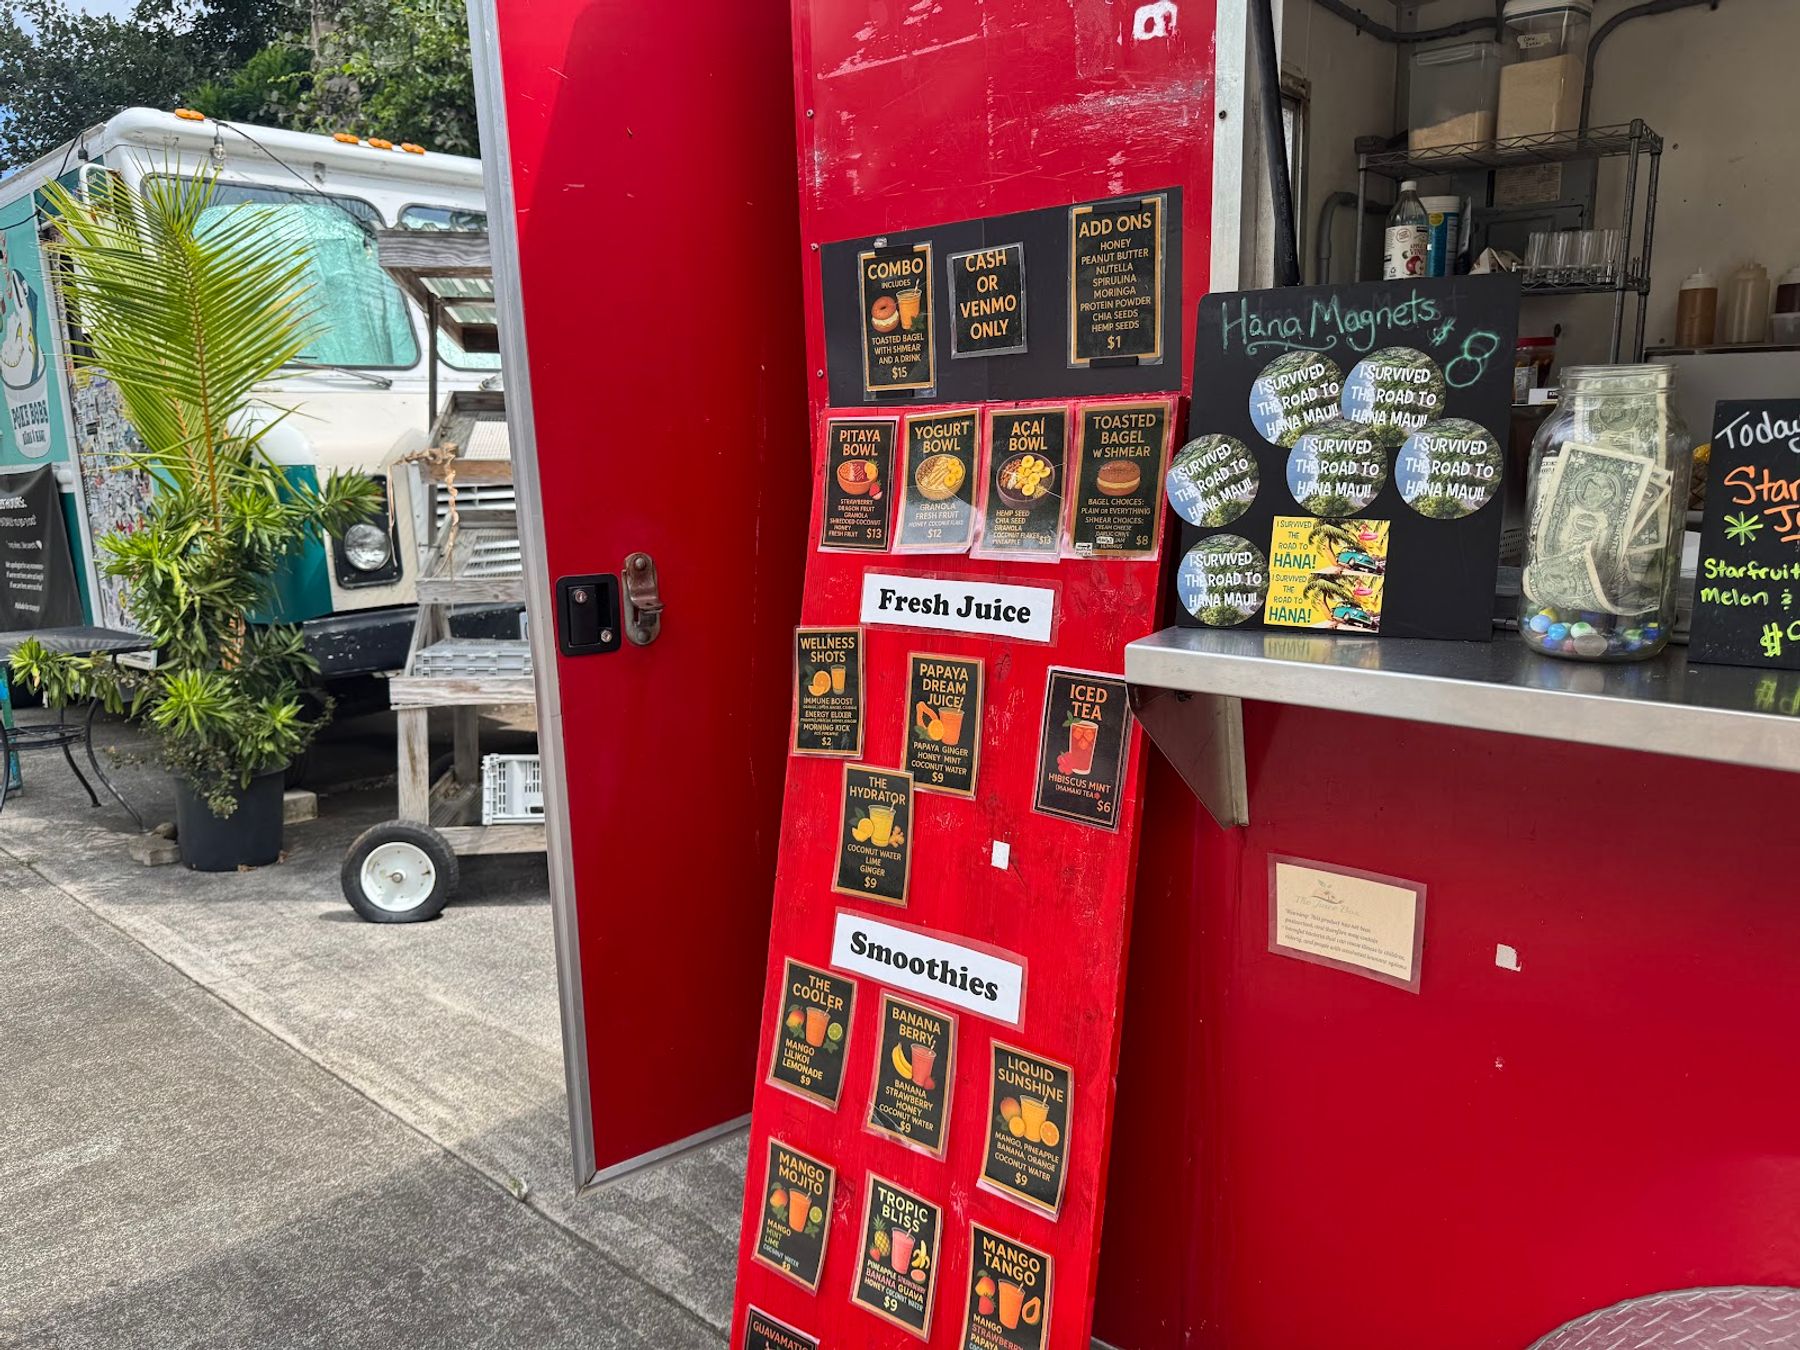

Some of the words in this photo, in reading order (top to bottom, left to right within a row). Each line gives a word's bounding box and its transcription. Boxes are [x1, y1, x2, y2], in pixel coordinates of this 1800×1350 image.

[1079, 219, 1112, 238] ADD
[1117, 212, 1152, 232] ONS
[1101, 238, 1131, 250] HONEY
[965, 249, 1007, 272] CASH
[1081, 252, 1114, 265] PEANUT
[1117, 248, 1149, 261] BUTTER
[868, 258, 923, 279] COMBO
[1096, 263, 1133, 275] NUTELLA
[881, 279, 911, 289] INCLUDES
[977, 275, 998, 292] OR
[1093, 274, 1137, 287] SPIRULINA
[1094, 286, 1136, 298] MORINGA
[960, 295, 1016, 318] VENMO
[1080, 299, 1113, 311] PROTEIN
[1115, 297, 1151, 308] POWDER
[1093, 312, 1112, 321] CHIA
[1114, 309, 1138, 319] SEEDS
[1310, 289, 1440, 351] Magnets
[970, 319, 1009, 339] ONLY
[1092, 323, 1113, 333] HEMP
[1116, 321, 1139, 330] SEEDS
[872, 335, 900, 345] TOASTED
[902, 333, 924, 342] BAGEL
[1107, 336, 1121, 349] $1
[874, 347, 892, 355] WITH
[893, 344, 921, 354] SHMEAR
[879, 355, 894, 364] AND
[900, 353, 921, 363] DRINK
[892, 367, 907, 379] $15
[1264, 363, 1325, 393] SURVIVED
[1367, 364, 1431, 383] SURVIVED
[1282, 388, 1318, 410] ROAD
[1320, 382, 1339, 395] TO
[1375, 388, 1414, 404] ROAD
[1418, 392, 1436, 406] TO
[1093, 414, 1156, 429] TOASTED
[1351, 409, 1387, 425] HANA
[915, 422, 969, 439] YOGURT
[1012, 417, 1045, 437] AÇAÍ
[1266, 416, 1302, 436] HANA
[840, 430, 880, 442] PITAYA
[1009, 436, 1047, 451] BOWL
[1101, 430, 1145, 444] BAGEL
[843, 444, 878, 456] BOWL
[923, 439, 960, 453] BOWL
[1104, 446, 1150, 457] SHMEAR
[1310, 439, 1372, 454] SURVIVED
[1422, 436, 1487, 456] SURVIVED
[1179, 443, 1231, 480] SURVIVED
[1320, 461, 1357, 475] ROAD
[1361, 462, 1379, 476] TO
[1431, 460, 1471, 478] ROAD
[1475, 463, 1494, 478] TO
[1198, 467, 1230, 492] ROAD
[1230, 458, 1249, 473] TO
[1109, 507, 1150, 515] EVERYTHING
[1280, 520, 1312, 528] SURVIVED
[867, 528, 882, 538] $13
[927, 529, 942, 538] $12
[1136, 535, 1148, 546] $8
[1195, 552, 1253, 567] SURVIVED
[1276, 574, 1307, 582] SURVIVED
[1704, 558, 1800, 581] Starfruit
[1208, 574, 1241, 587] ROAD
[1245, 571, 1262, 584] TO
[878, 588, 949, 616] Fresh
[956, 596, 1031, 623] Juice
[1700, 588, 1769, 606] Melon
[801, 637, 855, 649] WELLNESS
[811, 651, 846, 663] SHOTS
[920, 664, 968, 681] PAPAYA
[923, 679, 966, 695] DREAM
[1070, 684, 1107, 704] ICED
[1072, 702, 1102, 720] TEA
[821, 737, 832, 746] $2
[914, 742, 939, 753] PAPAYA
[942, 746, 968, 757] GINGER
[918, 752, 940, 761] HONEY
[944, 756, 961, 764] MINT
[912, 760, 944, 771] COCONUT
[945, 765, 967, 775] WATER
[869, 776, 887, 789] THE
[932, 772, 944, 783] $9
[1048, 773, 1087, 788] HIBISCUS
[1088, 781, 1111, 794] MINT
[850, 786, 906, 805] HYDRATOR
[1096, 800, 1111, 813] $6
[848, 843, 879, 856] COCONUT
[880, 850, 901, 860] WATER
[866, 857, 881, 866] LIME
[860, 865, 885, 876] GINGER
[864, 877, 877, 888] $9
[850, 931, 999, 1001] Smoothies
[809, 975, 831, 992] THE
[793, 983, 843, 1011] COOLER
[892, 1007, 941, 1035] BANANA
[899, 1024, 934, 1046] BERRY
[786, 1038, 815, 1056] MANGO
[784, 1048, 810, 1064] LILIKOI
[782, 1058, 823, 1080] LEMONADE
[1008, 1056, 1054, 1082] LIQUID
[800, 1075, 811, 1086] $9
[895, 1080, 926, 1098] BANANA
[998, 1068, 1064, 1103] SUNSHINE
[886, 1086, 933, 1111] STRAWBERRY
[879, 1104, 910, 1121] COCONUT
[912, 1116, 934, 1131] WATER
[896, 1101, 922, 1117] HONEY
[900, 1121, 911, 1133] $9
[995, 1131, 1023, 1149] MANGO,
[1024, 1143, 1059, 1164] PINEAPPLE
[997, 1142, 1026, 1161] BANANA,
[1027, 1155, 1055, 1172] ORANGE
[780, 1151, 824, 1182] MANGO
[994, 1153, 1027, 1171] COCONUT
[1028, 1166, 1050, 1182] WATER
[779, 1164, 822, 1195] MOJITO
[1015, 1172, 1028, 1186] $9
[878, 1186, 928, 1223] TROPIC
[882, 1204, 920, 1233] BLISS
[768, 1219, 791, 1236] MANGO
[983, 1236, 1040, 1273] MANGO
[867, 1260, 897, 1280] PINEAPPLE
[983, 1251, 1035, 1286] TANGO
[864, 1277, 885, 1293] HONEY
[866, 1268, 896, 1289] BANANA
[898, 1284, 924, 1303] GUAVA
[884, 1296, 898, 1312] $9
[974, 1314, 1002, 1334] MANGO
